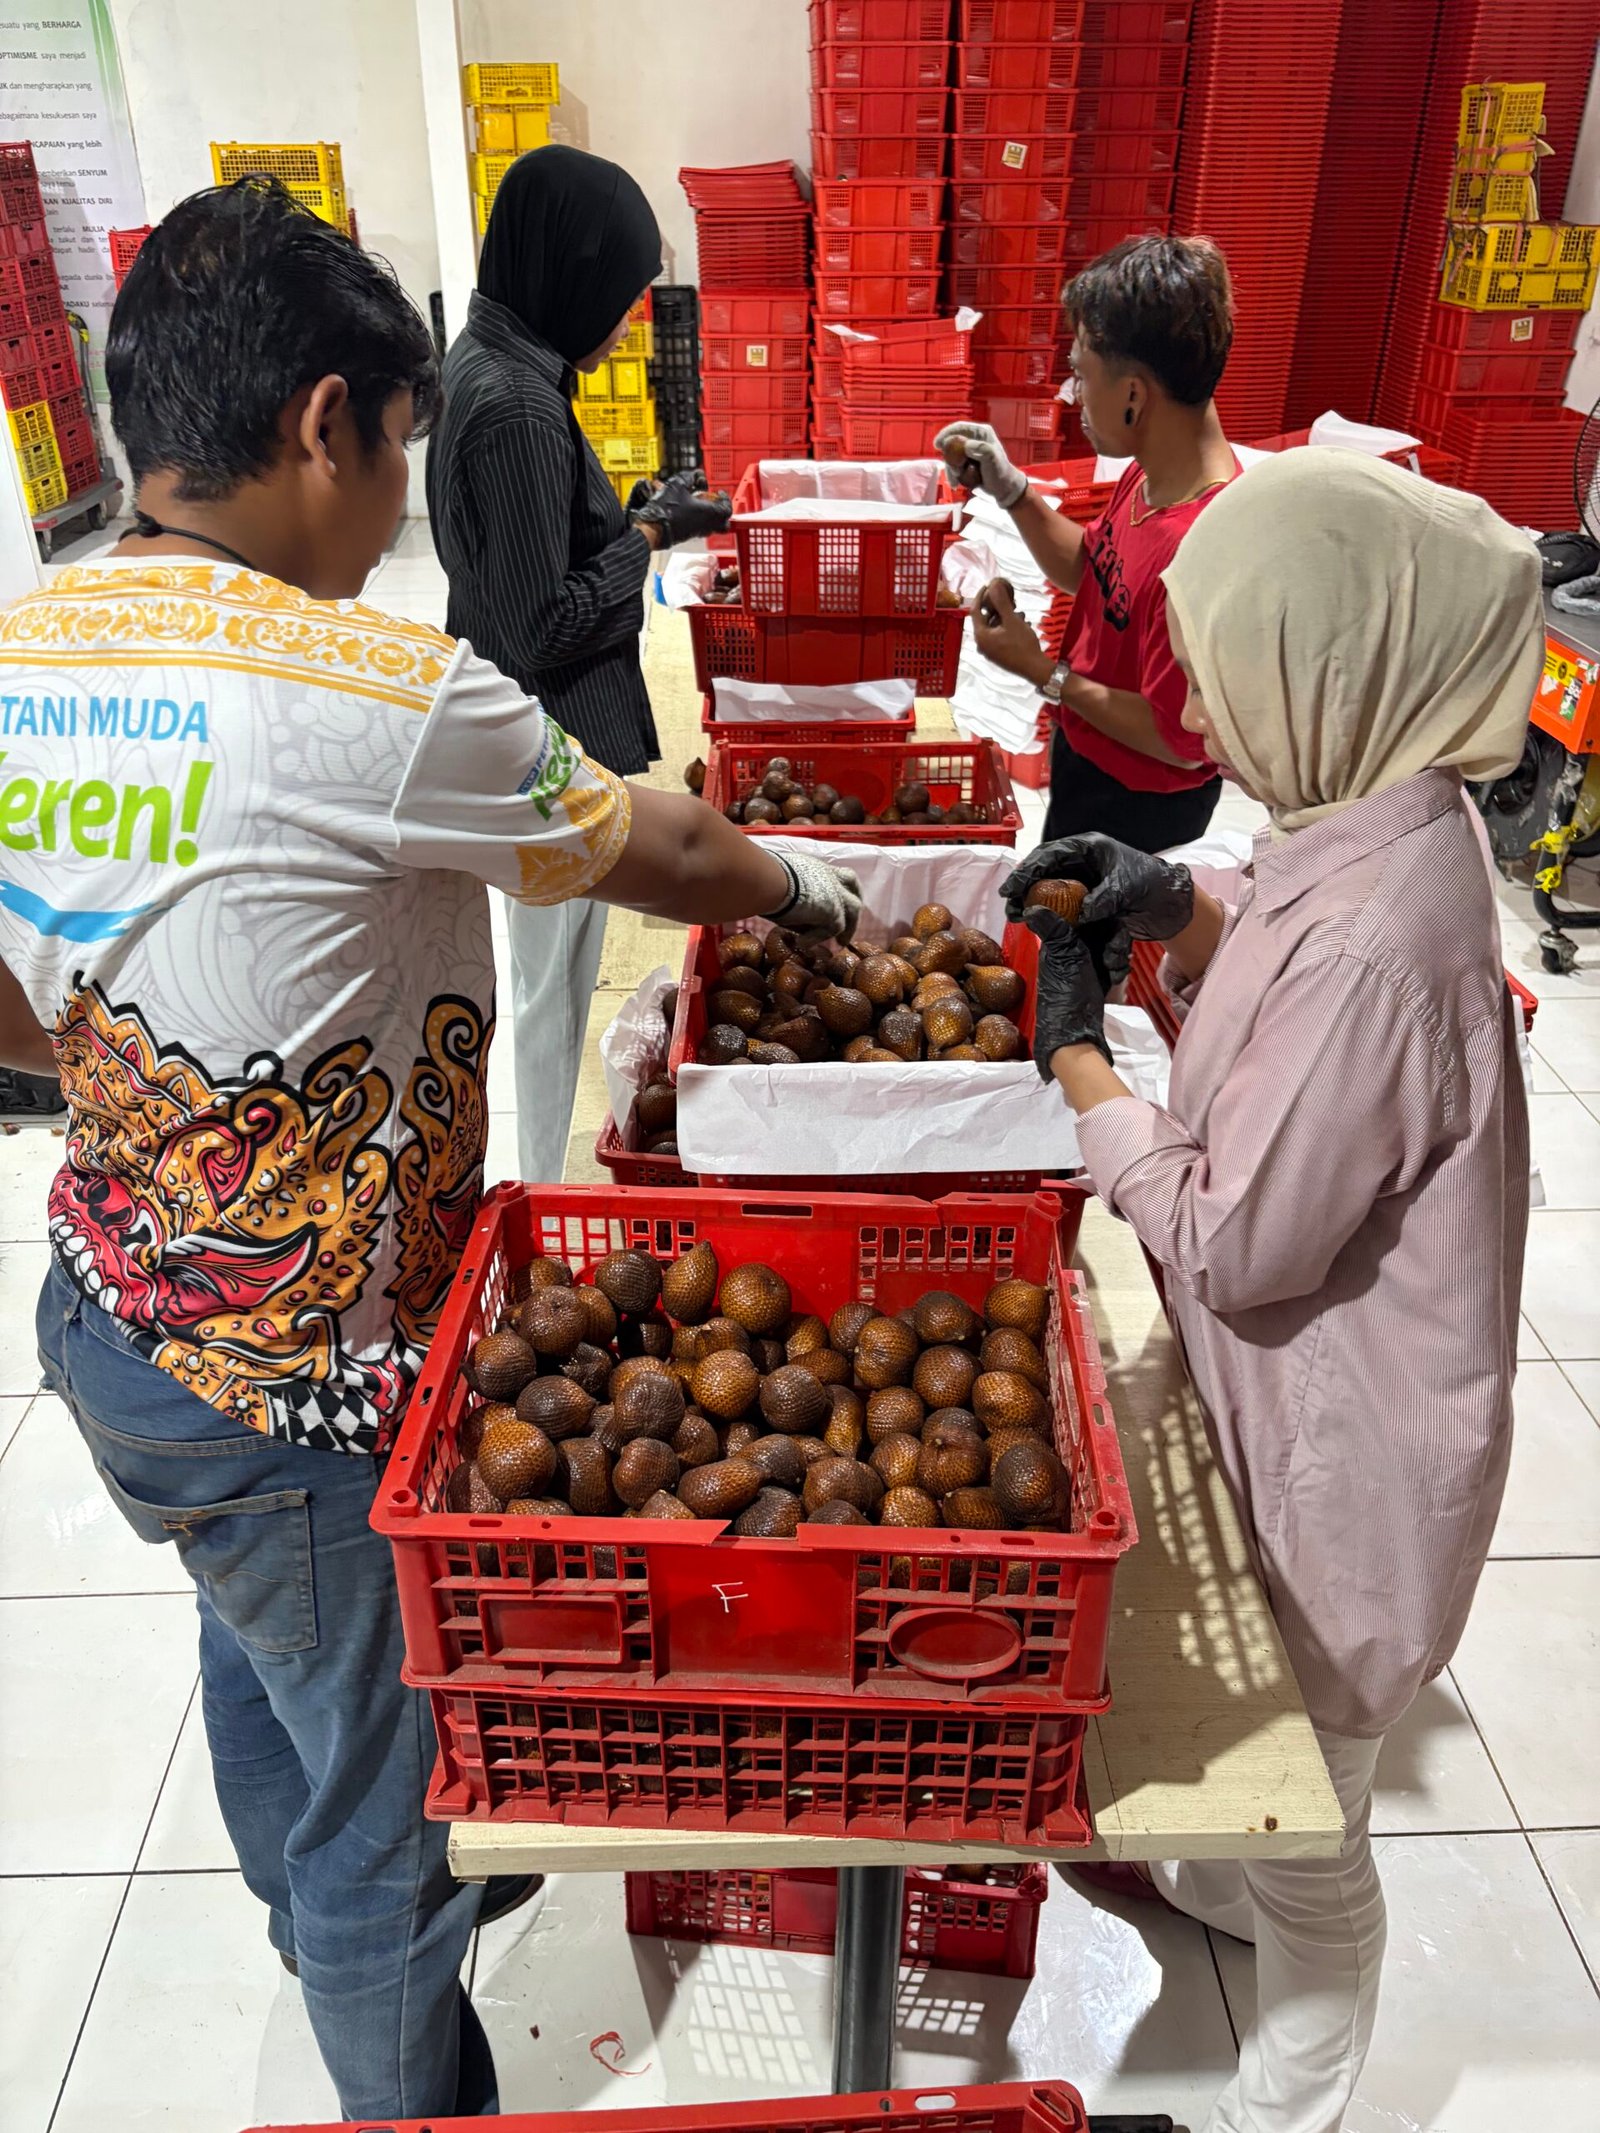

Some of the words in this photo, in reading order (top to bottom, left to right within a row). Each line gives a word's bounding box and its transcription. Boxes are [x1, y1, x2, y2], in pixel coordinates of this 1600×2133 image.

[42, 21, 81, 29] BERHARGA
[67, 142, 85, 150] yang
[77, 169, 108, 177] SENYUM
[0, 696, 77, 737] TANI
[88, 697, 209, 743] MUDA
[0, 751, 215, 867] eren!
[711, 1581, 749, 1613] F
